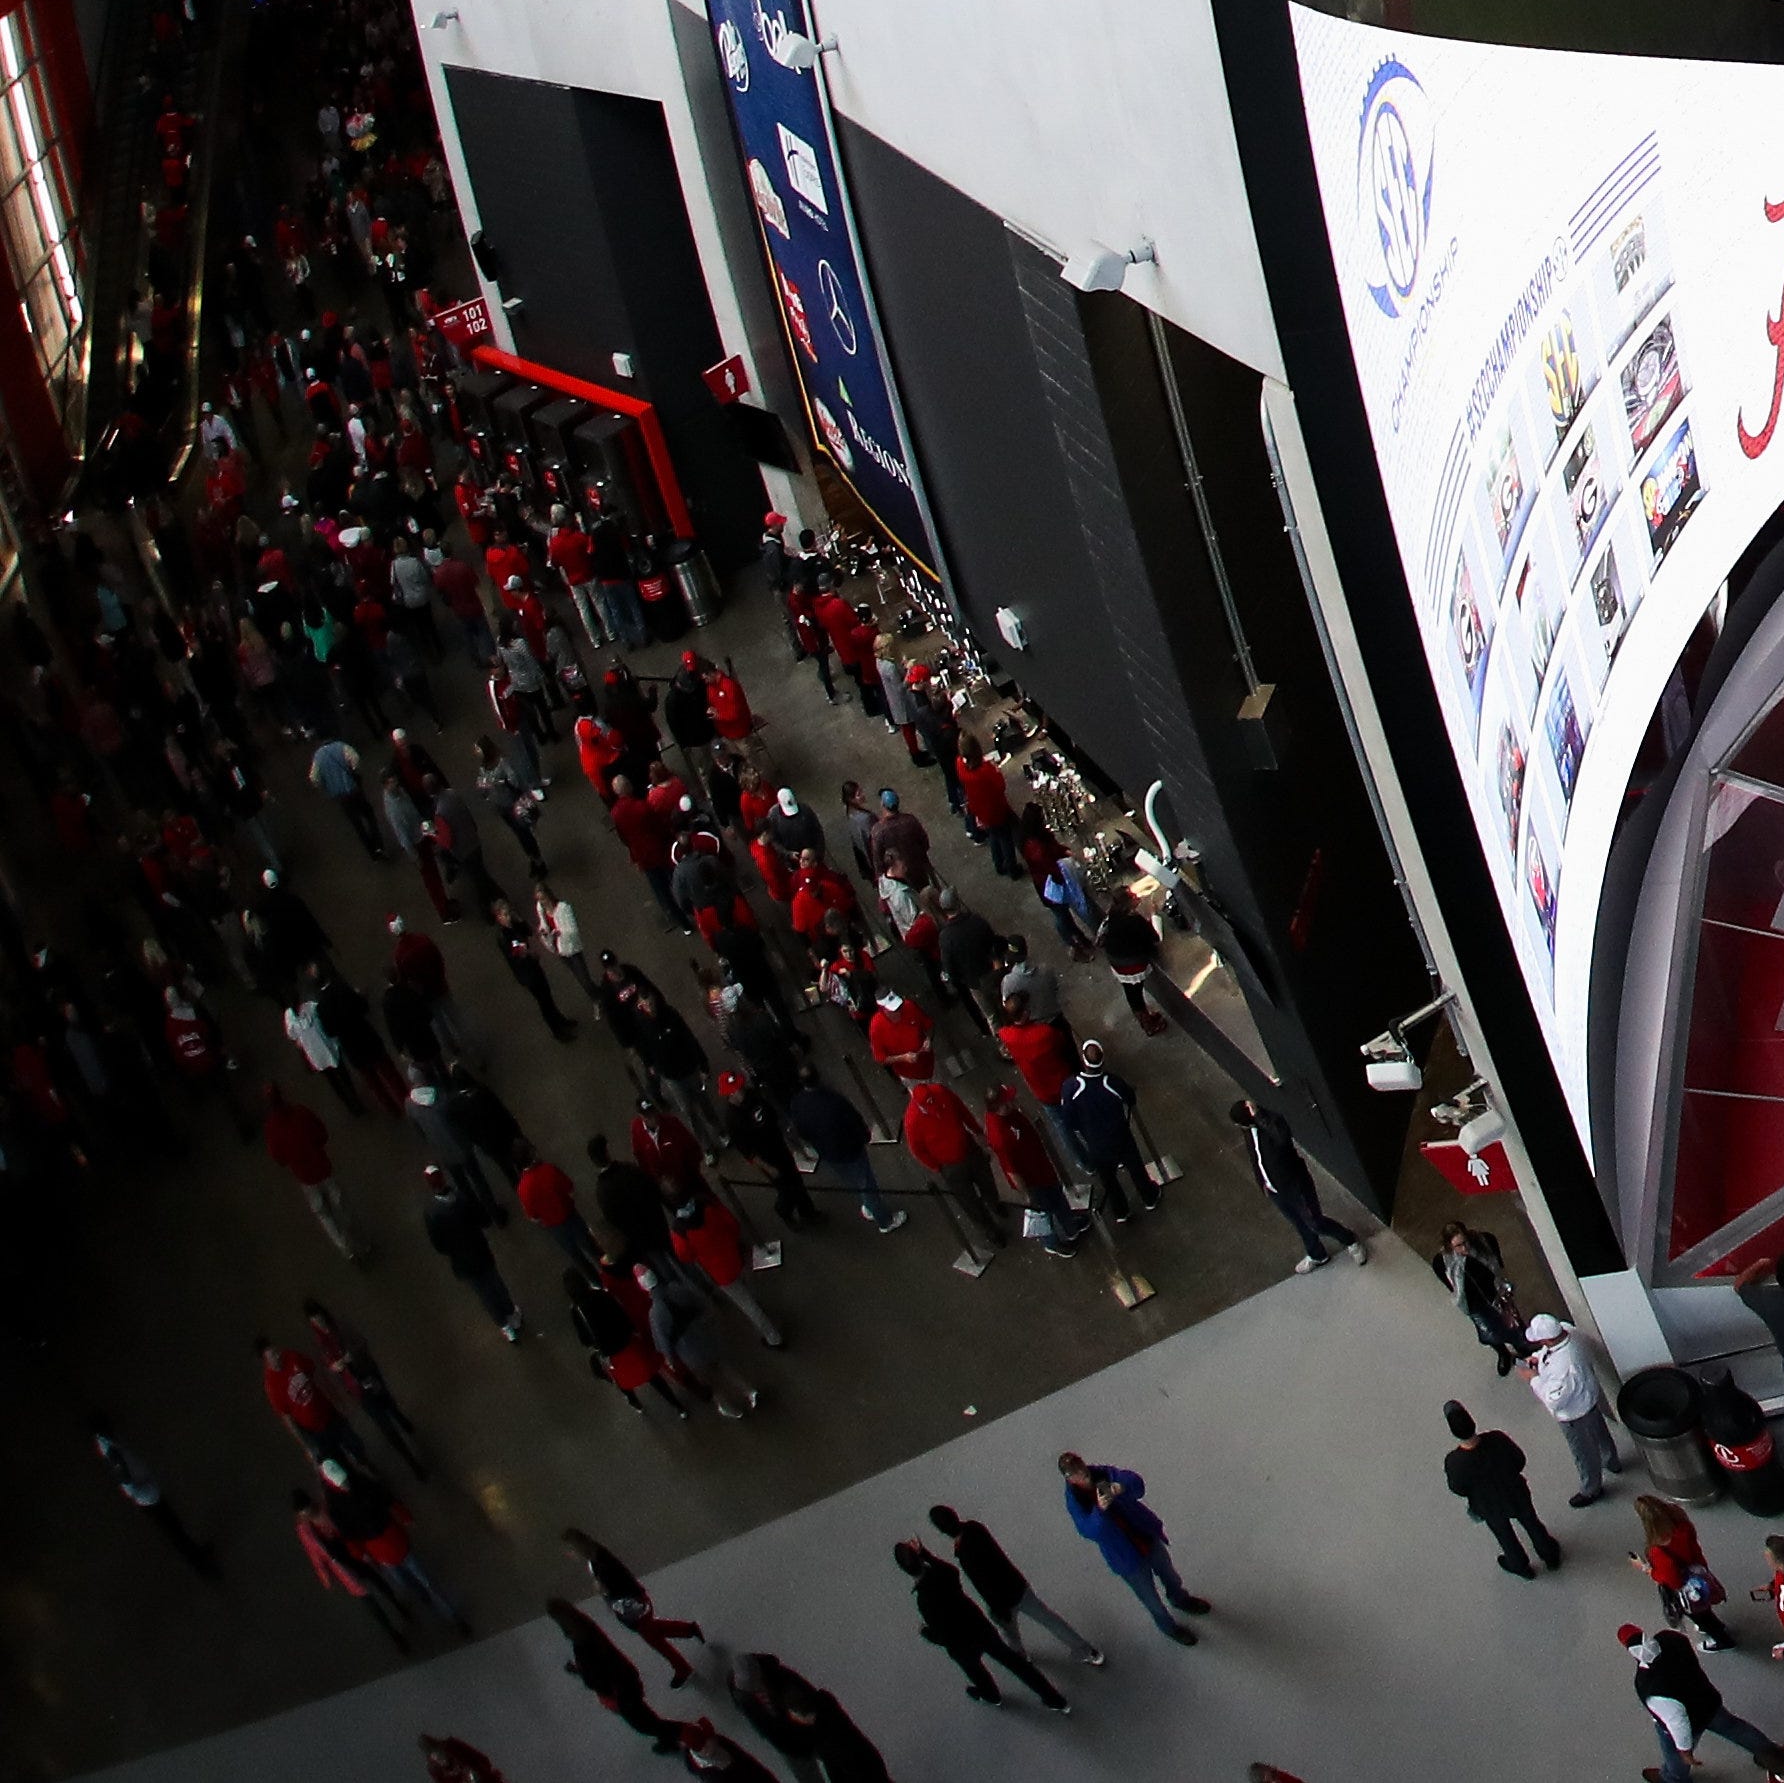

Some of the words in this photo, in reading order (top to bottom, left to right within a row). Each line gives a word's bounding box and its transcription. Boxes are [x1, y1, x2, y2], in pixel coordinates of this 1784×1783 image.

[1372, 108, 1422, 295] SEC
[463, 305, 483, 323] 101
[466, 318, 488, 336] 102
[1391, 235, 1462, 436] CHAMPIONSHIP
[1465, 254, 1555, 444] #SECCHAMPIONSHIP
[846, 406, 913, 489] REGION
